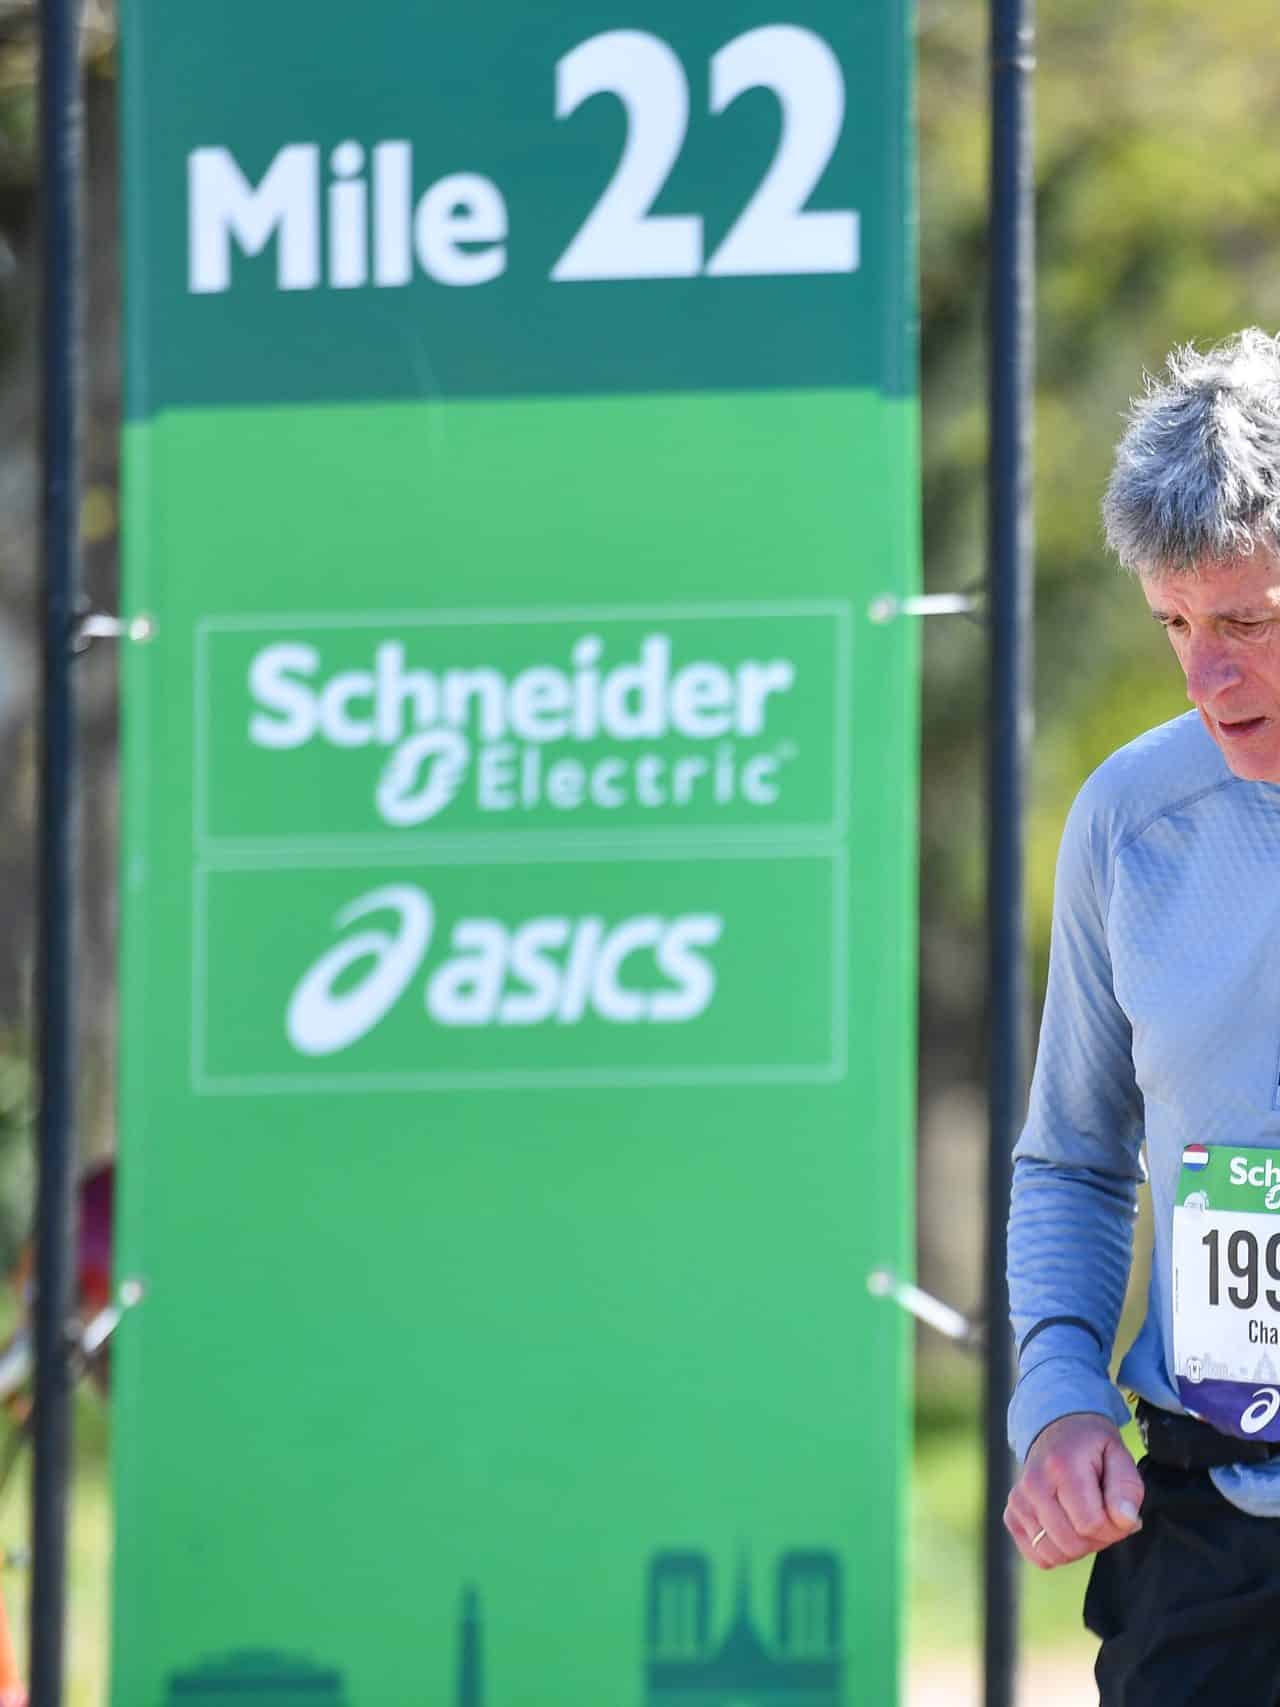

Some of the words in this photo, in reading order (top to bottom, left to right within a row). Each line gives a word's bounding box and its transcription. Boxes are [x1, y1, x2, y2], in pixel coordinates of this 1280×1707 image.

[187, 139, 509, 294] Mile
[549, 24, 861, 282] 22
[247, 634, 795, 749] Schneider
[476, 741, 781, 811] Electric
[425, 912, 722, 1026] asics
